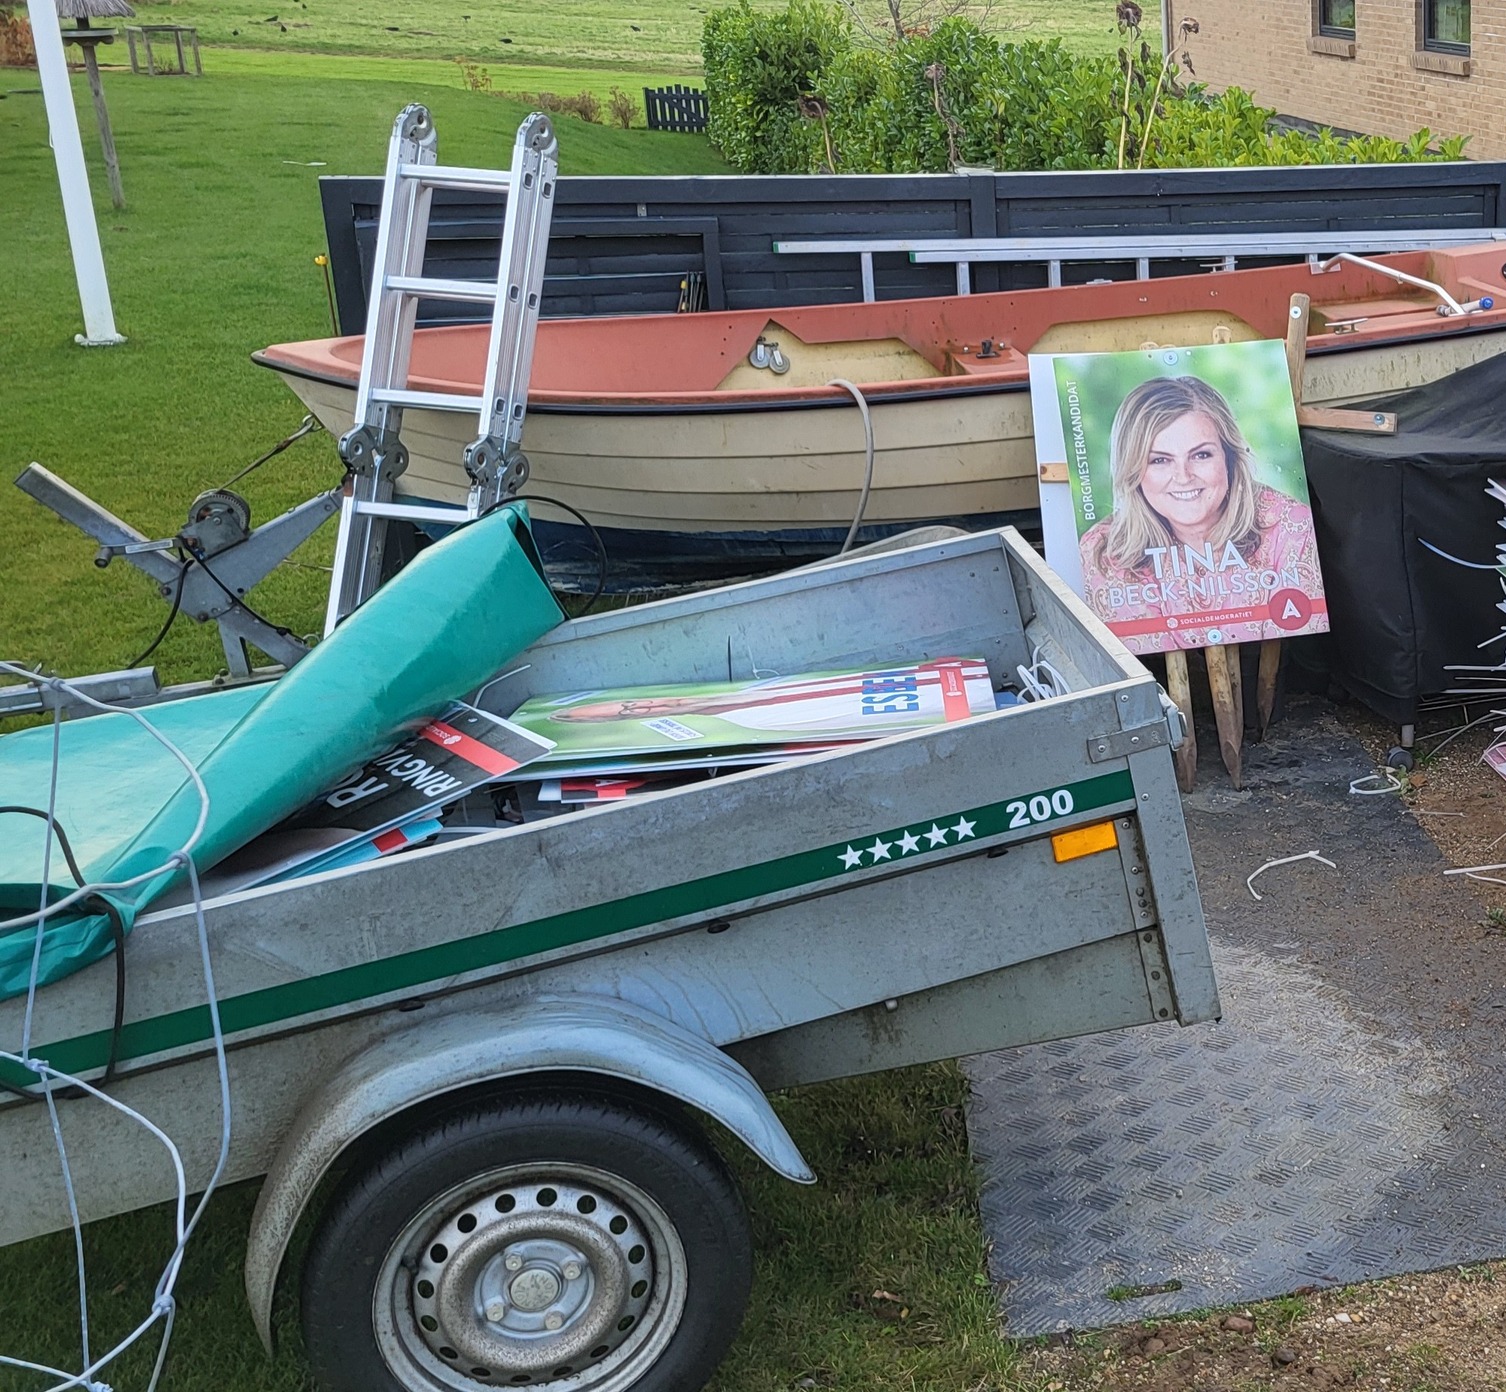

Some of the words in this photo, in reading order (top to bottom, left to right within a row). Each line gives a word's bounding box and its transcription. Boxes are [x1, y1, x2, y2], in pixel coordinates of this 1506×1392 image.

[1066, 380, 1096, 520] BORGMESTERKANDIDAT
[1144, 539, 1249, 580] TINA
[1109, 567, 1301, 608] BECK-NILSSON
[1179, 611, 1253, 625] SOCIALDEMOKRATIET
[1281, 598, 1302, 620] A
[1005, 789, 1074, 829] 200
